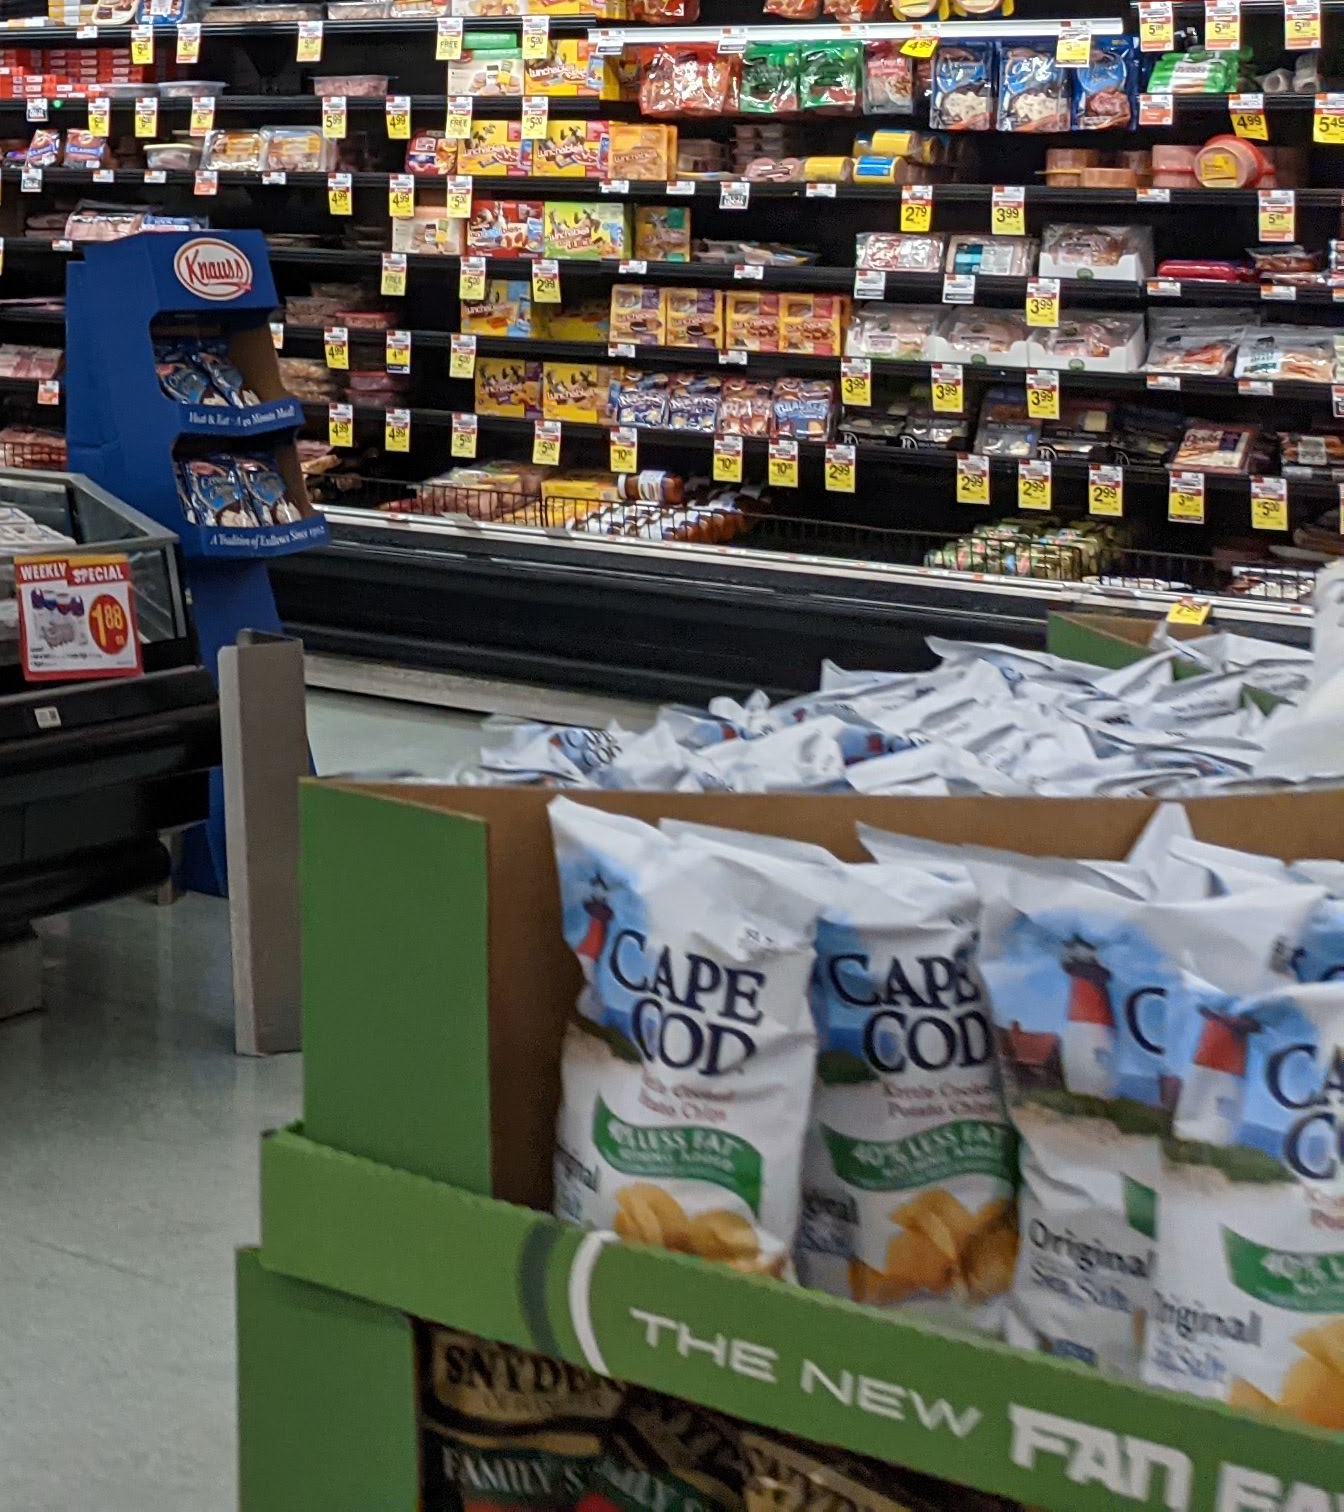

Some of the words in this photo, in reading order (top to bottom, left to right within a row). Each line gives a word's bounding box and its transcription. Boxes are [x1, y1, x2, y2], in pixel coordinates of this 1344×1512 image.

[389, 115, 406, 128] 499
[1236, 115, 1262, 130] 499
[331, 191, 347, 205] 499
[392, 193, 409, 206] 499
[905, 206, 927, 222] 279
[996, 208, 1019, 223] 399
[184, 250, 245, 286] Knauss
[536, 279, 555, 292] 299
[1030, 299, 1053, 314] 399
[845, 379, 866, 394] 399
[936, 384, 957, 399] 399
[1031, 390, 1054, 406] 399
[829, 464, 850, 479] 299
[961, 475, 984, 491] 299
[1022, 480, 1045, 496] 299
[1093, 487, 1117, 502] 299
[20, 562, 67, 581] WEEKLY
[72, 564, 124, 583] SPECIAL
[92, 603, 123, 647] 188
[610, 928, 765, 1027] CAPE
[828, 954, 982, 1011] CAPE
[631, 997, 757, 1076] COD
[863, 1010, 993, 1073] COD
[1028, 1217, 1157, 1279] Original
[1154, 1288, 1263, 1347] riginal
[628, 1306, 779, 1383] THE
[799, 1357, 983, 1437] NEW
[442, 1446, 553, 1494] FAMILY
